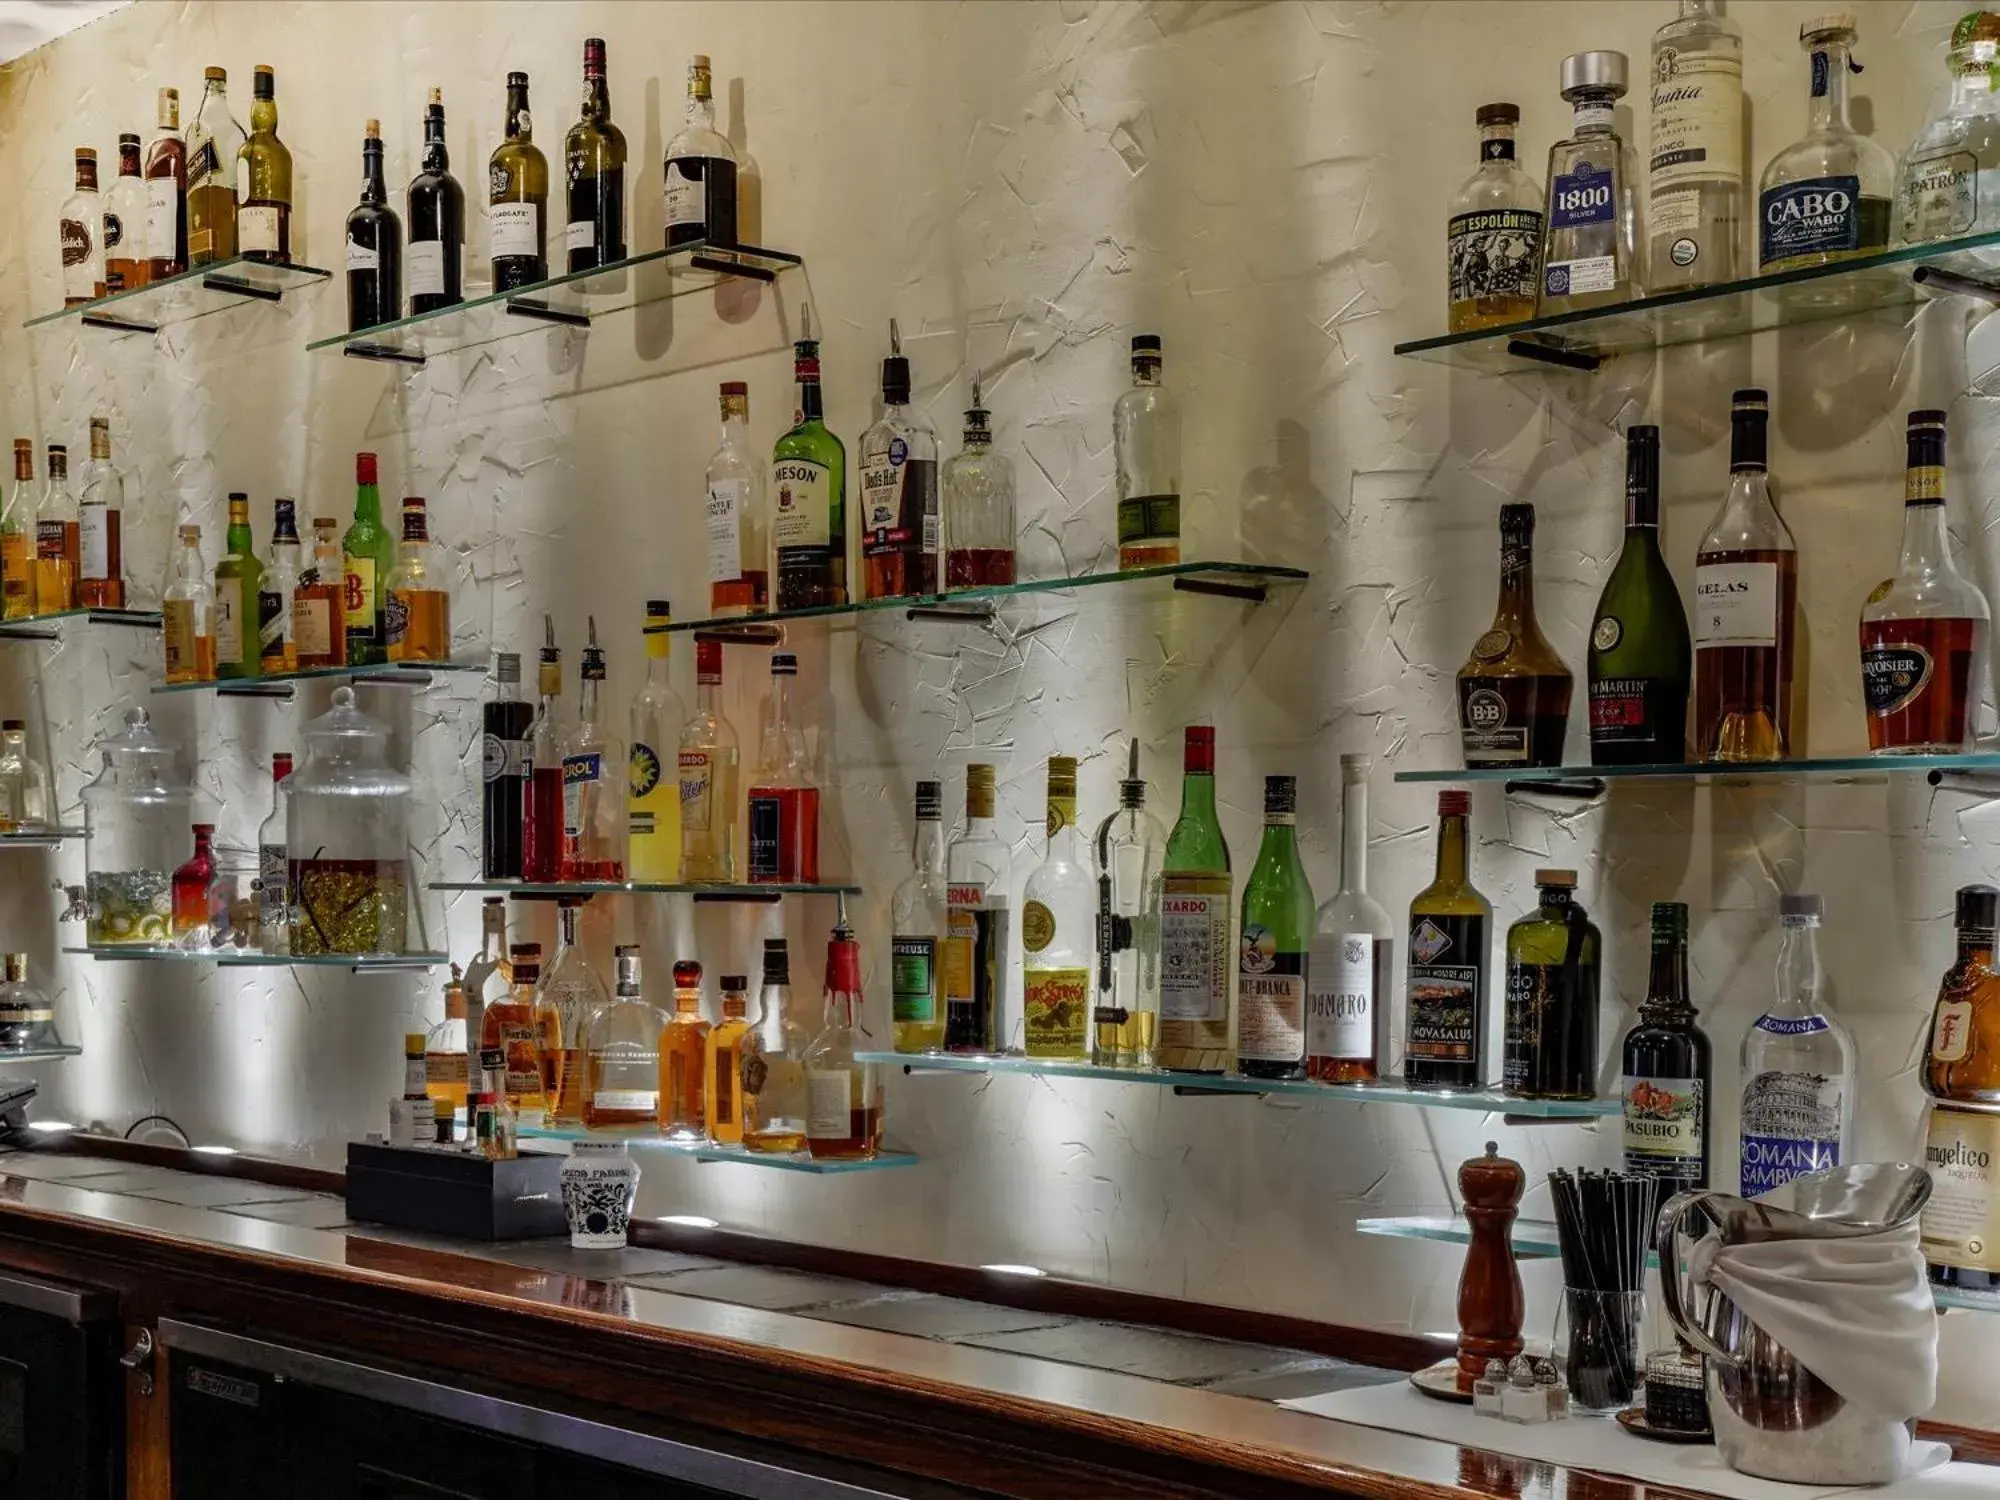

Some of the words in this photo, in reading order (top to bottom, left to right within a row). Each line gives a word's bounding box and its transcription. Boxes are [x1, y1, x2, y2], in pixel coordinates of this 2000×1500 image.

[1558, 186, 1609, 212] 1800
[1767, 191, 1850, 225] CABO
[1803, 214, 1845, 227] WABO
[1713, 616, 1721, 627] 8
[1763, 1019, 1817, 1033] ROMANA
[1741, 1142, 1833, 1171] ROMANA
